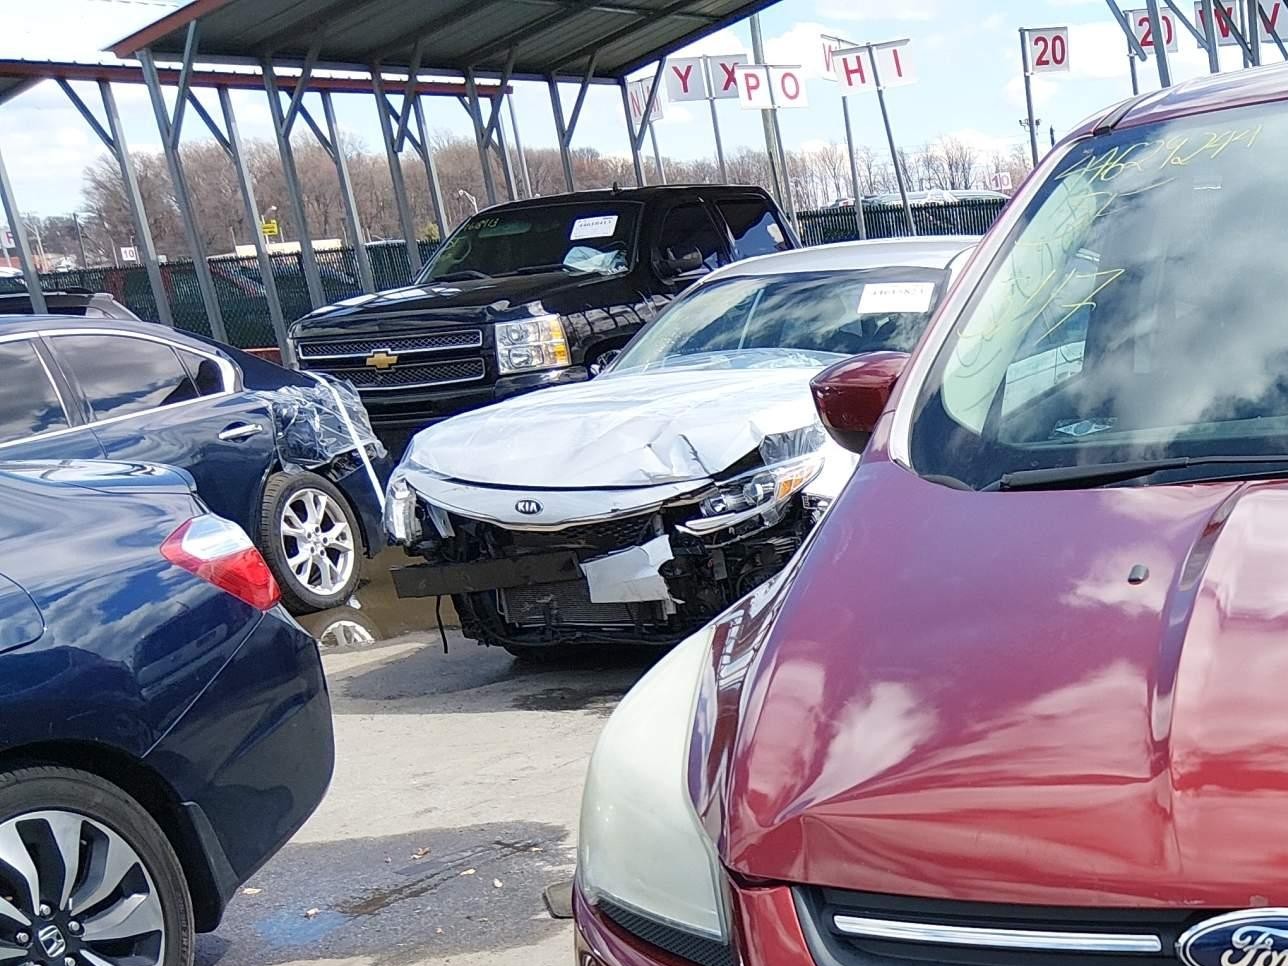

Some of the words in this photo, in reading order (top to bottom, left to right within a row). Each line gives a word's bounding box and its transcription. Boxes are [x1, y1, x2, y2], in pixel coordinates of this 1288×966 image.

[1033, 34, 1066, 66] 20
[671, 64, 693, 93] Y
[719, 62, 740, 91] X
[842, 55, 866, 87] H
[743, 73, 760, 101] P
[781, 72, 800, 100] O
[992, 174, 1009, 188] 10
[123, 249, 135, 259] 10
[517, 501, 538, 512] KIA
